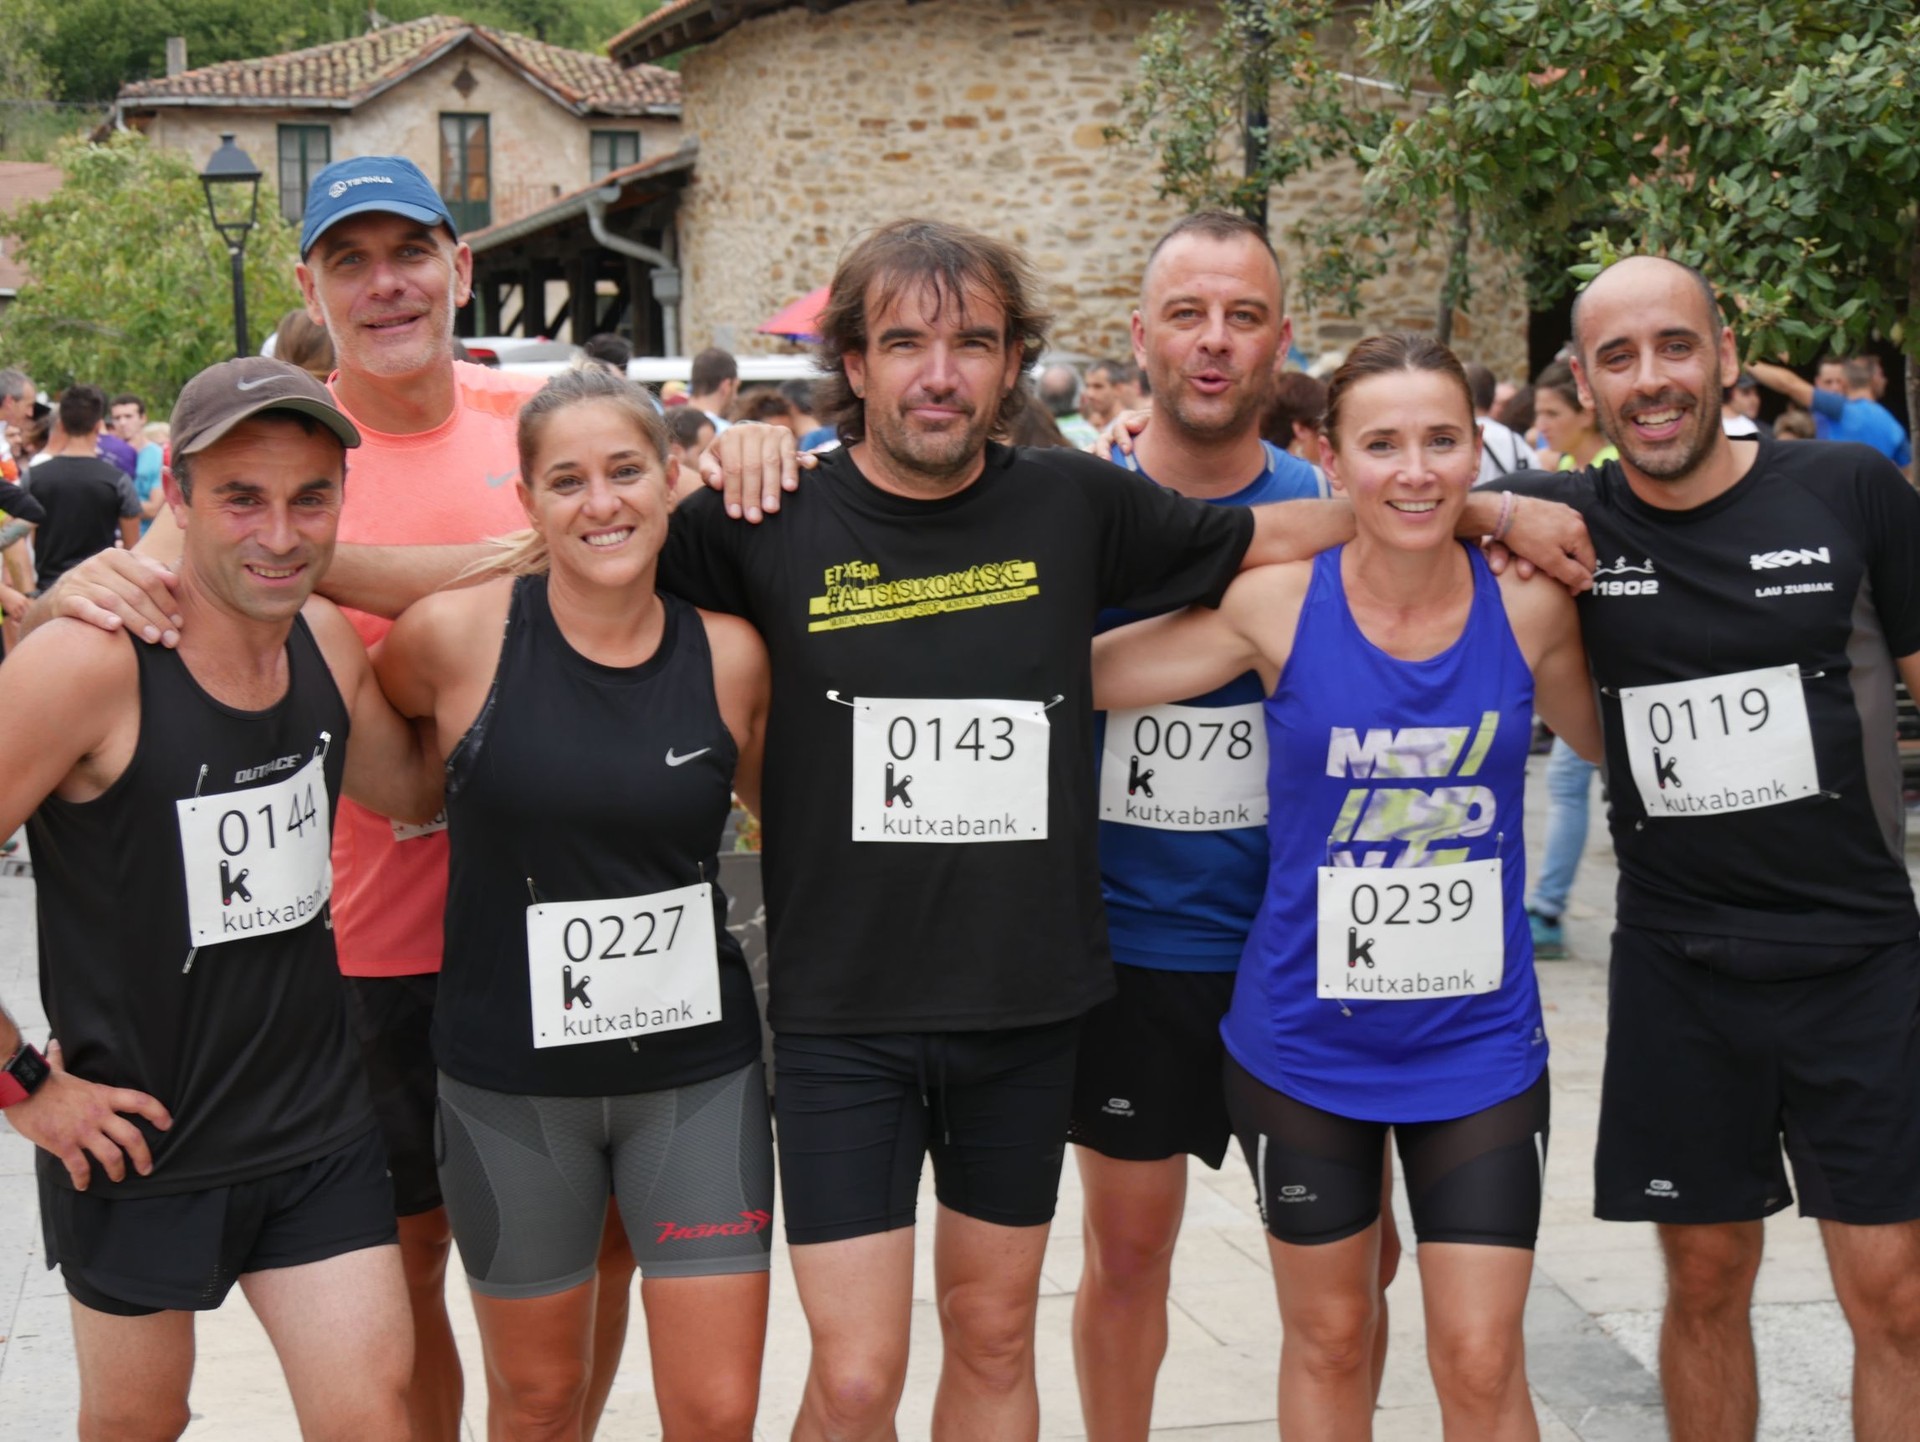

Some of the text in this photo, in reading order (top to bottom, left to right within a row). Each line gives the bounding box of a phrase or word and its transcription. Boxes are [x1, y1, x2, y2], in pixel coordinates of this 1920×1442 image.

[345, 175, 394, 187] TERNUA
[824, 560, 880, 586] ETXERA
[1755, 582, 1834, 598] LAU ZUBIAK
[1649, 688, 1769, 744] 0119
[888, 716, 1015, 761] 0143
[1134, 716, 1252, 761] 0078
[1125, 799, 1250, 825] kutxabank
[1661, 779, 1788, 813] kutxabank
[218, 783, 316, 857] 0144
[883, 813, 1017, 836] kutxabank
[1351, 879, 1473, 925] 0239
[563, 905, 684, 962] 0227
[1346, 969, 1475, 994] kutxabank
[563, 1000, 693, 1037] kutxabank
